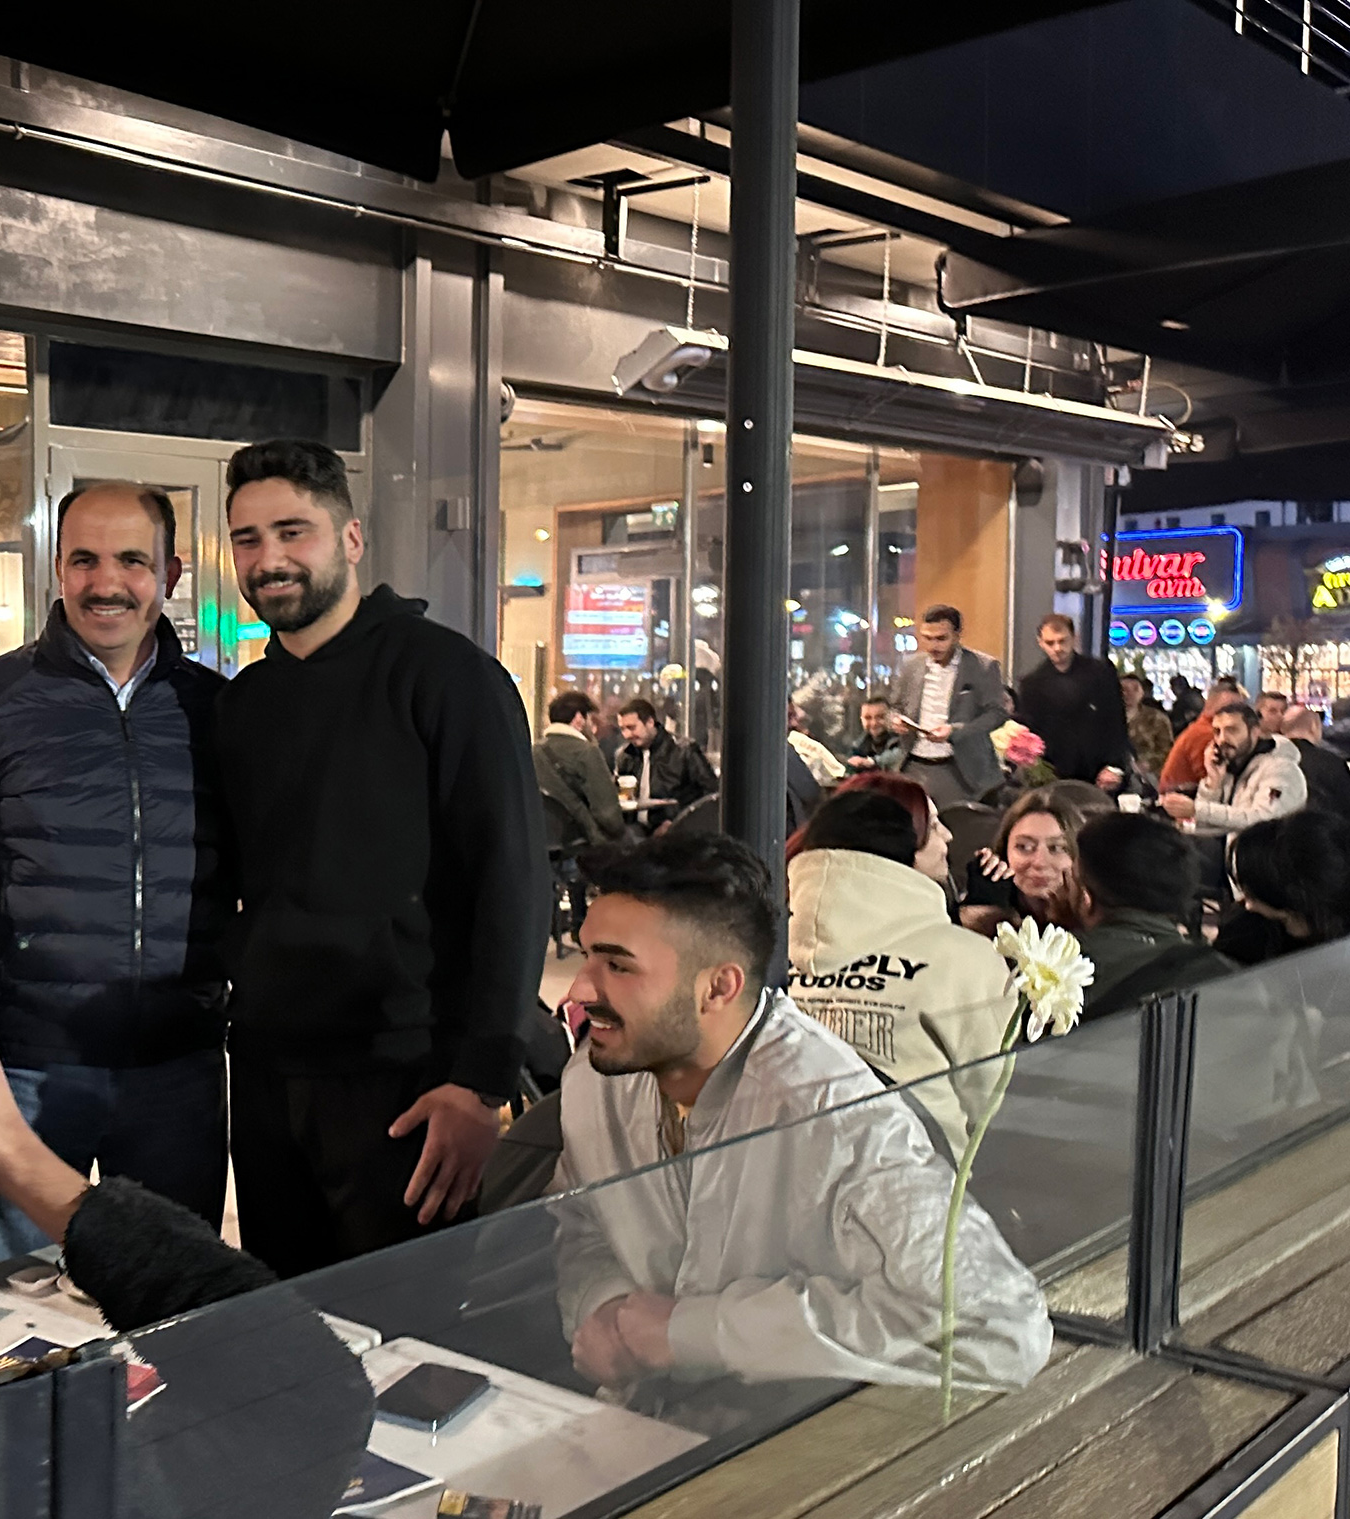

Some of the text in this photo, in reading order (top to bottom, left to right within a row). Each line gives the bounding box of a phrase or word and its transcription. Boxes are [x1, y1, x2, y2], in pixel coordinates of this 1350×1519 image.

[1100, 547, 1206, 580] ulvar
[1147, 576, 1206, 598] avm
[788, 954, 929, 980] PLY
[788, 974, 886, 991] TUDIOS
